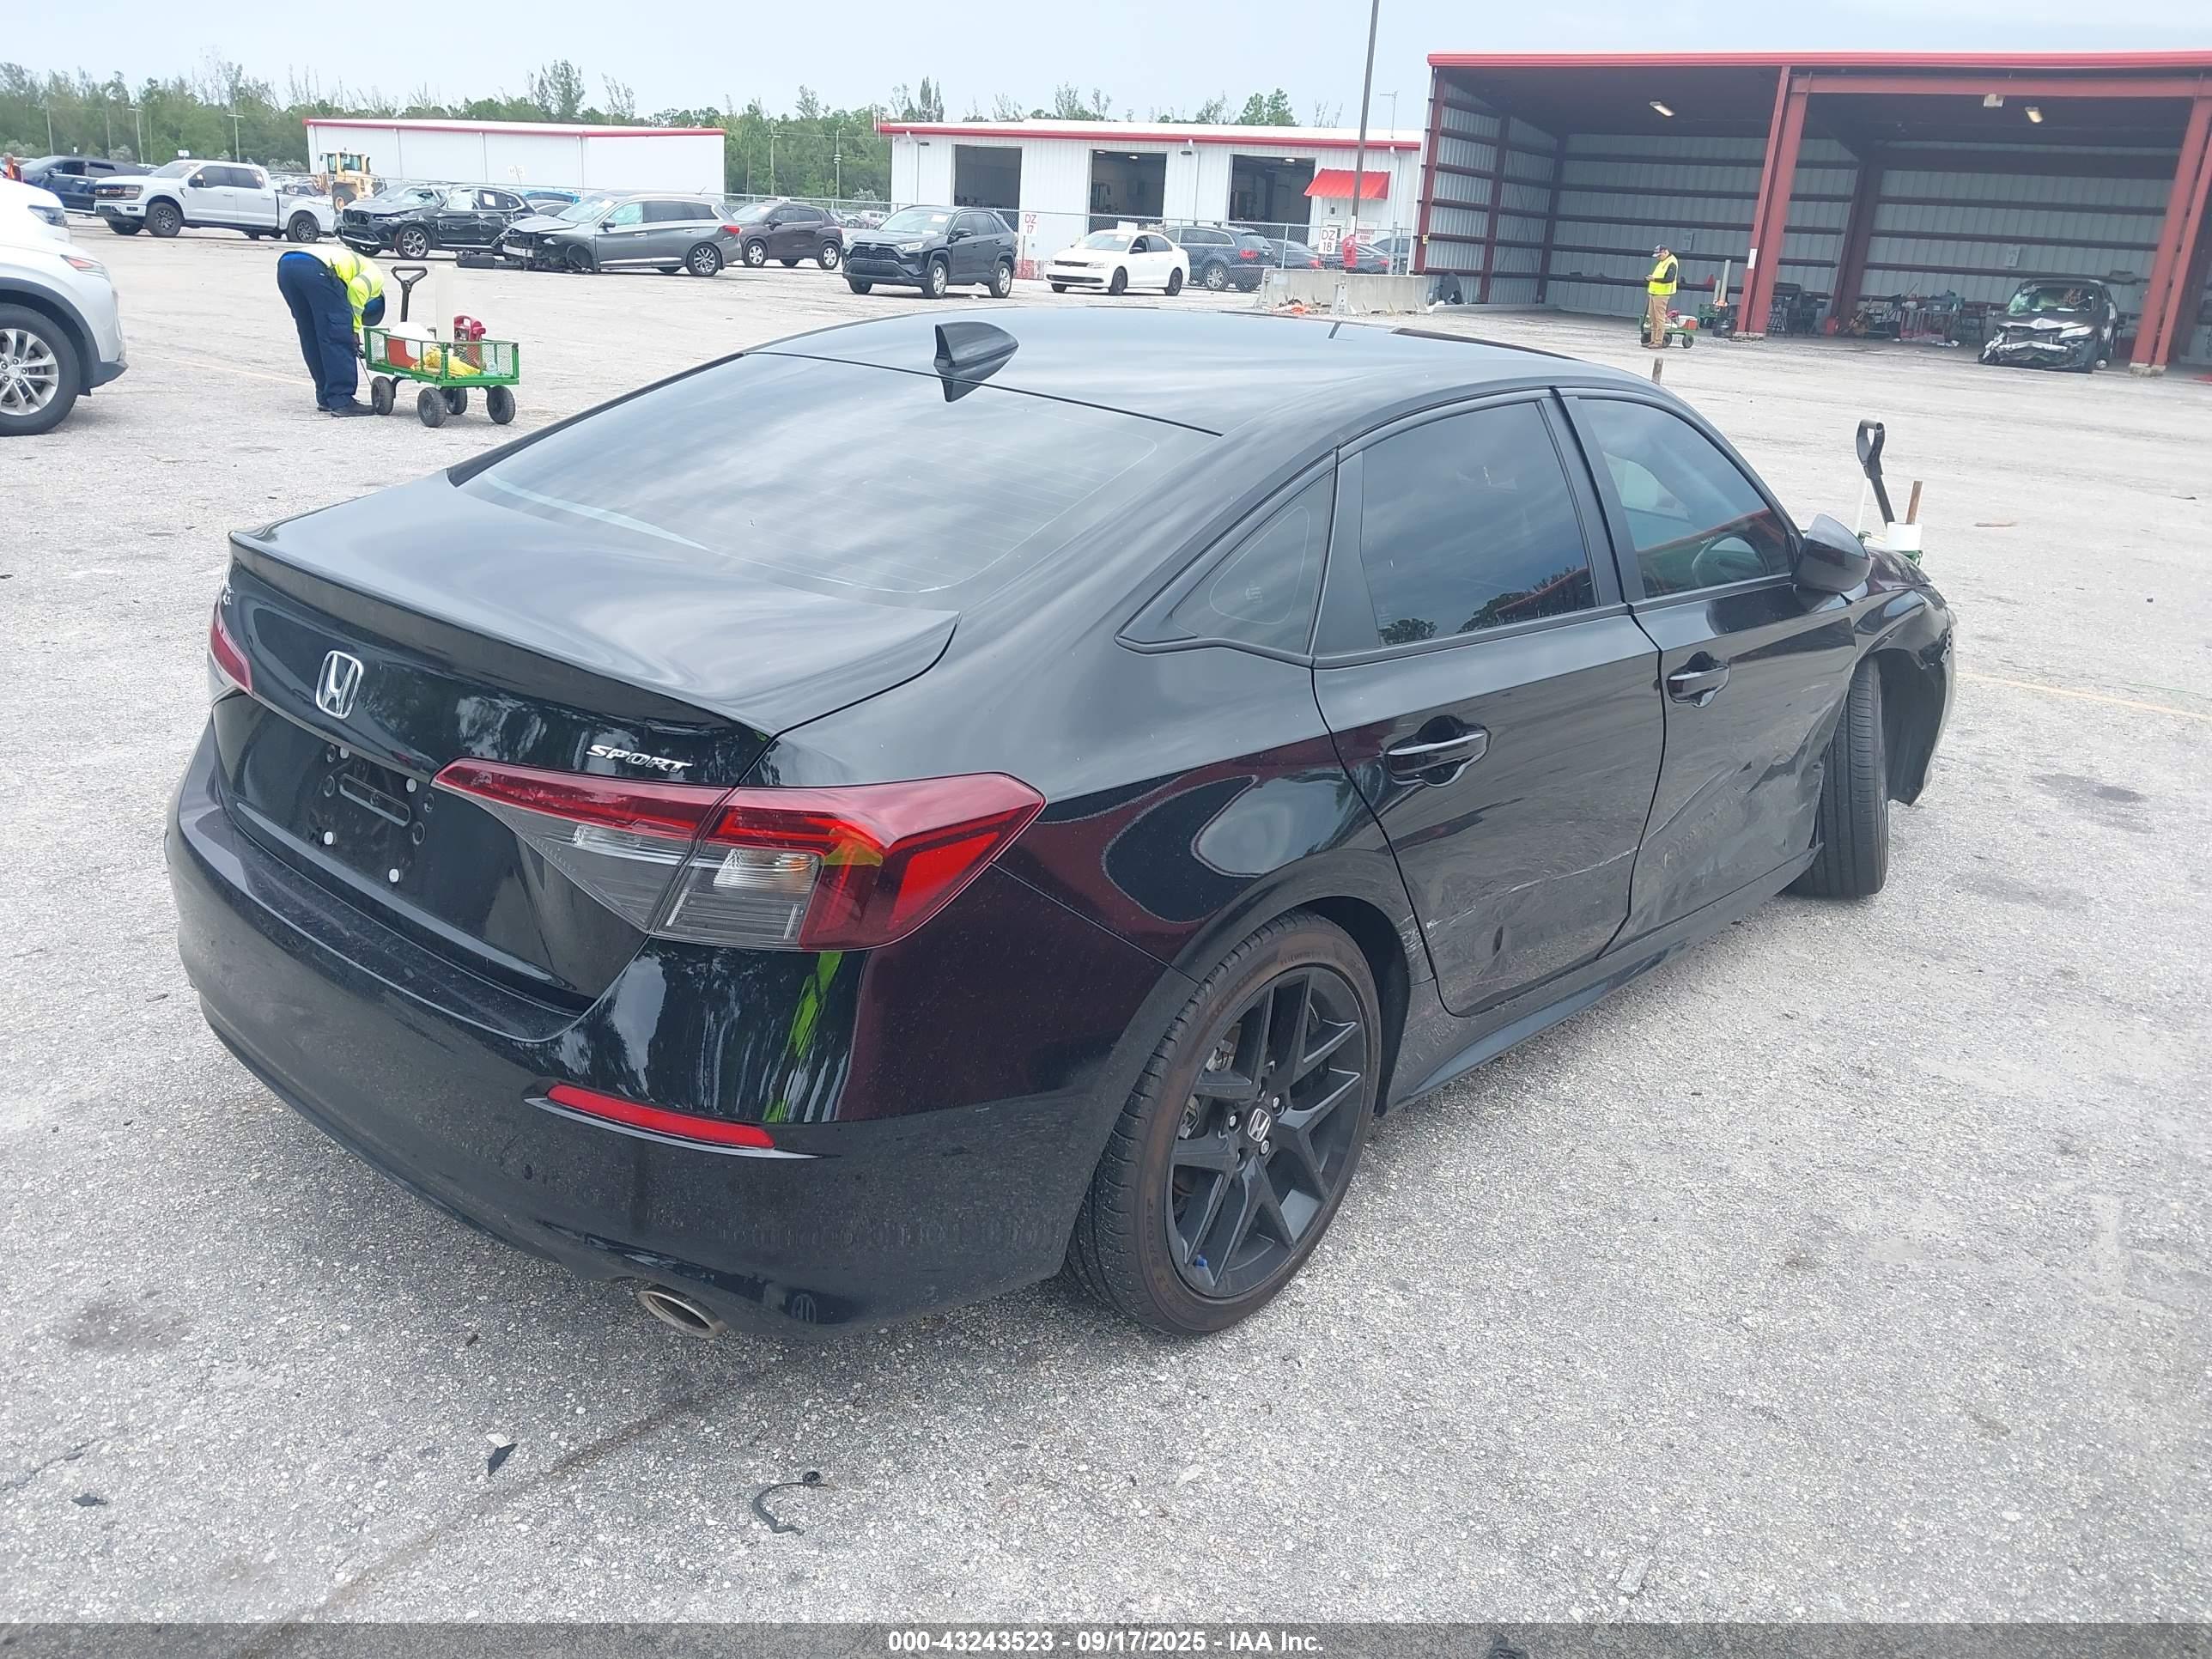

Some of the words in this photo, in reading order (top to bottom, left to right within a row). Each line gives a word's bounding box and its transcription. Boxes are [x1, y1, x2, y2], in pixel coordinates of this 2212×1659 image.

[1024, 214, 1036, 223] DZ
[1027, 225, 1034, 234] 17
[1322, 229, 1336, 240] DZ
[1323, 241, 1332, 252] 18
[586, 744, 693, 773] SPORT
